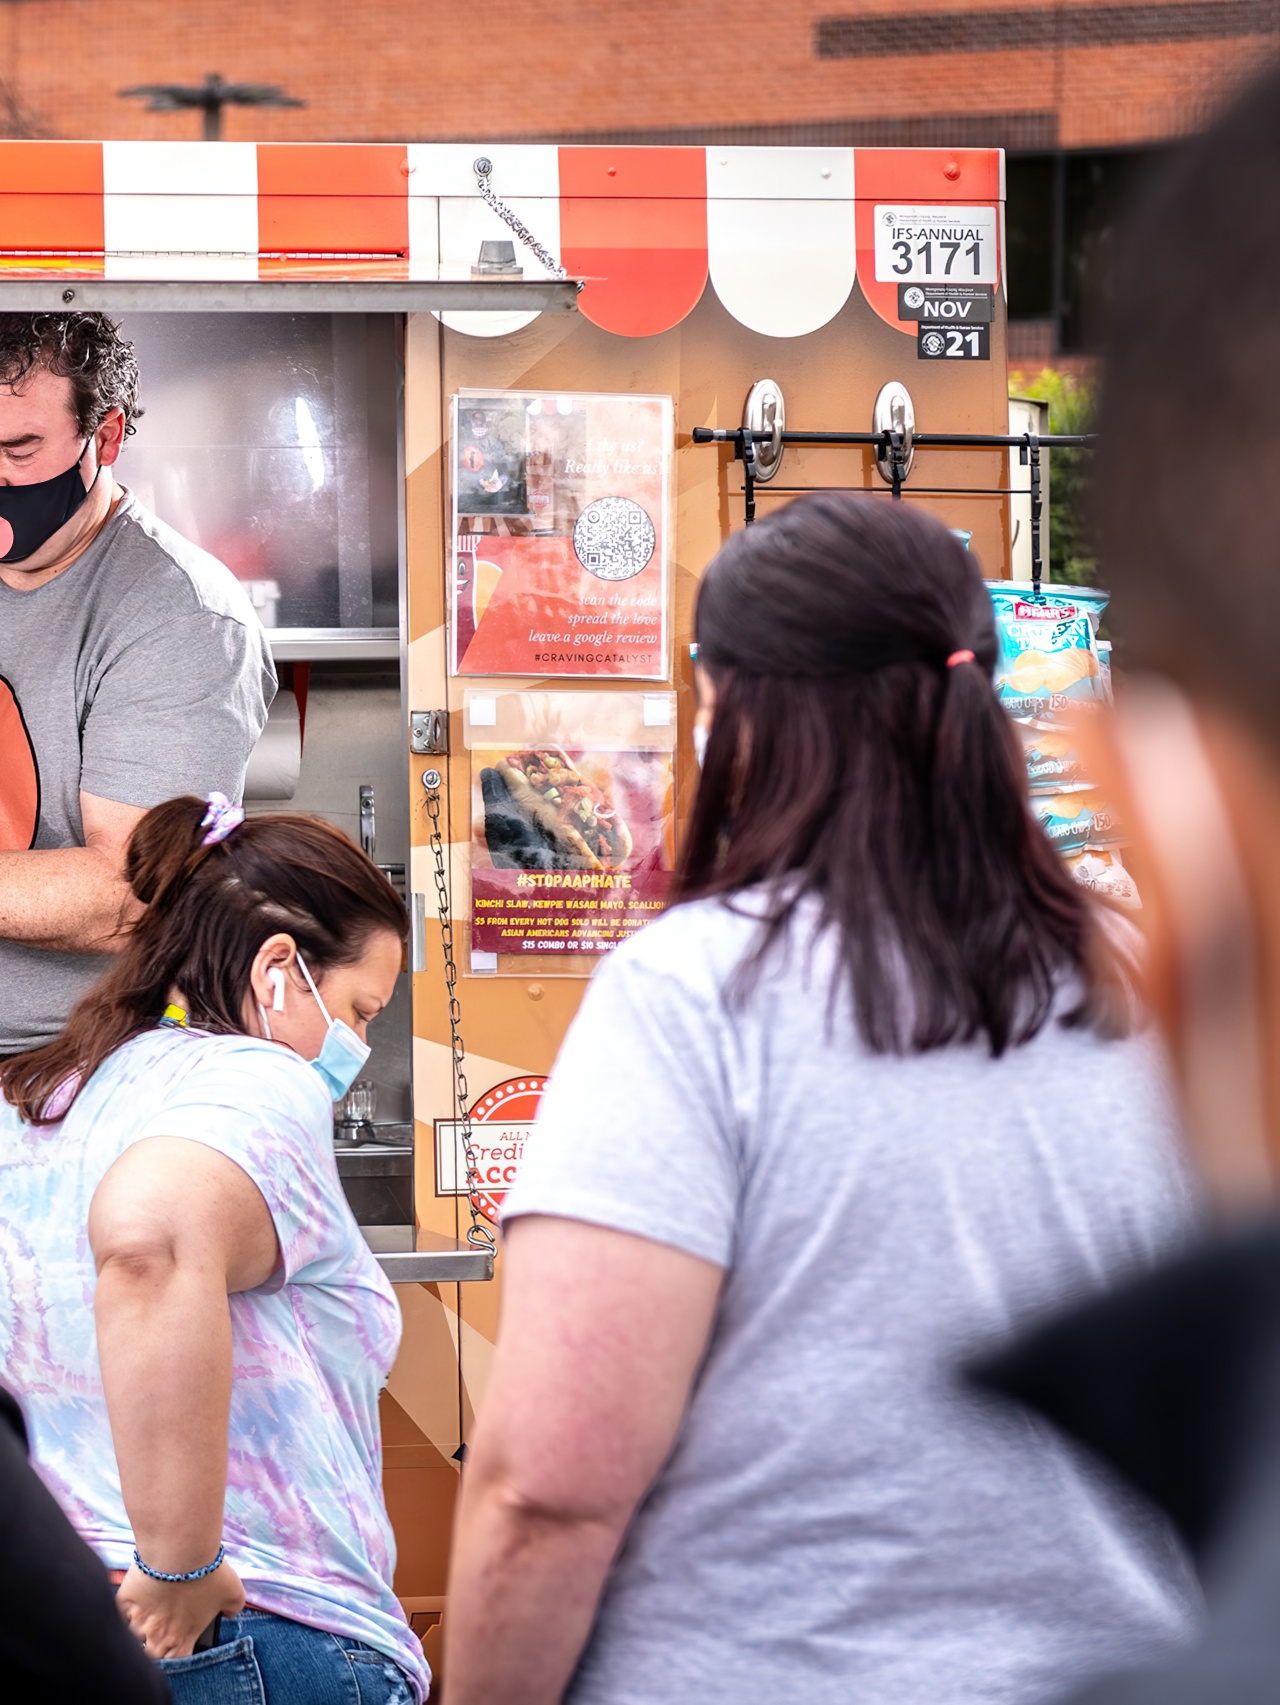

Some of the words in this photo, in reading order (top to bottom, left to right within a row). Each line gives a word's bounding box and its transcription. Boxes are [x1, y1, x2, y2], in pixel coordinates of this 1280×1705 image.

[892, 228, 983, 241] IFS-ANNUAL
[891, 241, 981, 275] 3171
[923, 301, 972, 318] NOV
[945, 331, 980, 357] 21
[564, 459, 609, 478] Really
[579, 595, 605, 605] scan
[609, 592, 628, 606] the
[567, 611, 607, 628] spread
[610, 610, 630, 624] the
[632, 613, 658, 625] love
[528, 629, 561, 642] leave
[563, 634, 571, 642] a
[573, 630, 613, 646] google
[615, 631, 658, 644] review
[535, 653, 653, 663] #CRAVINGCATALYST
[1051, 695, 1067, 709] 150
[1094, 814, 1111, 827] 150
[517, 874, 632, 889] #STOPAAPIHATE
[487, 917, 508, 925] FROM
[510, 917, 535, 926] EVERY
[537, 918, 552, 926] HOT
[554, 918, 569, 926] DOG
[501, 929, 524, 937] ASIAN
[526, 929, 569, 937] AMERICANS
[571, 930, 614, 938] ADVANCING
[537, 941, 565, 949] COMBO
[567, 941, 578, 949] OR
[581, 941, 594, 950] $10
[596, 942, 621, 950] SINGL
[499, 1131, 523, 1141] ALL
[466, 1143, 524, 1161] Credi
